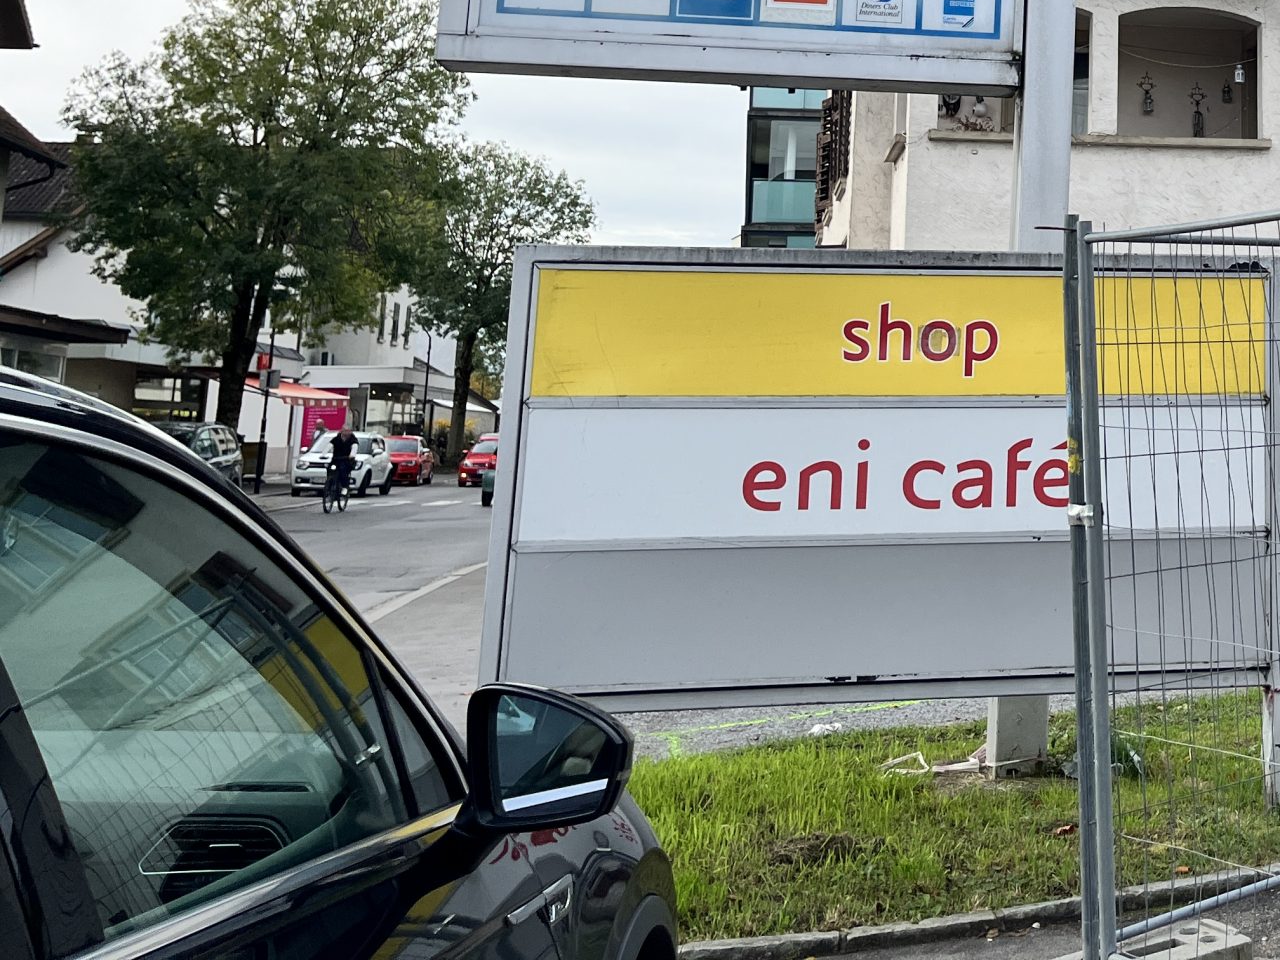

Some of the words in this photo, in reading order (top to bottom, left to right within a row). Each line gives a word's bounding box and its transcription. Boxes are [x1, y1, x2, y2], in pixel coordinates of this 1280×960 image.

[859, 9, 901, 17] International
[883, 3, 899, 11] Club
[842, 302, 999, 378] shop
[742, 438, 871, 511] eni
[902, 437, 1068, 510] café
